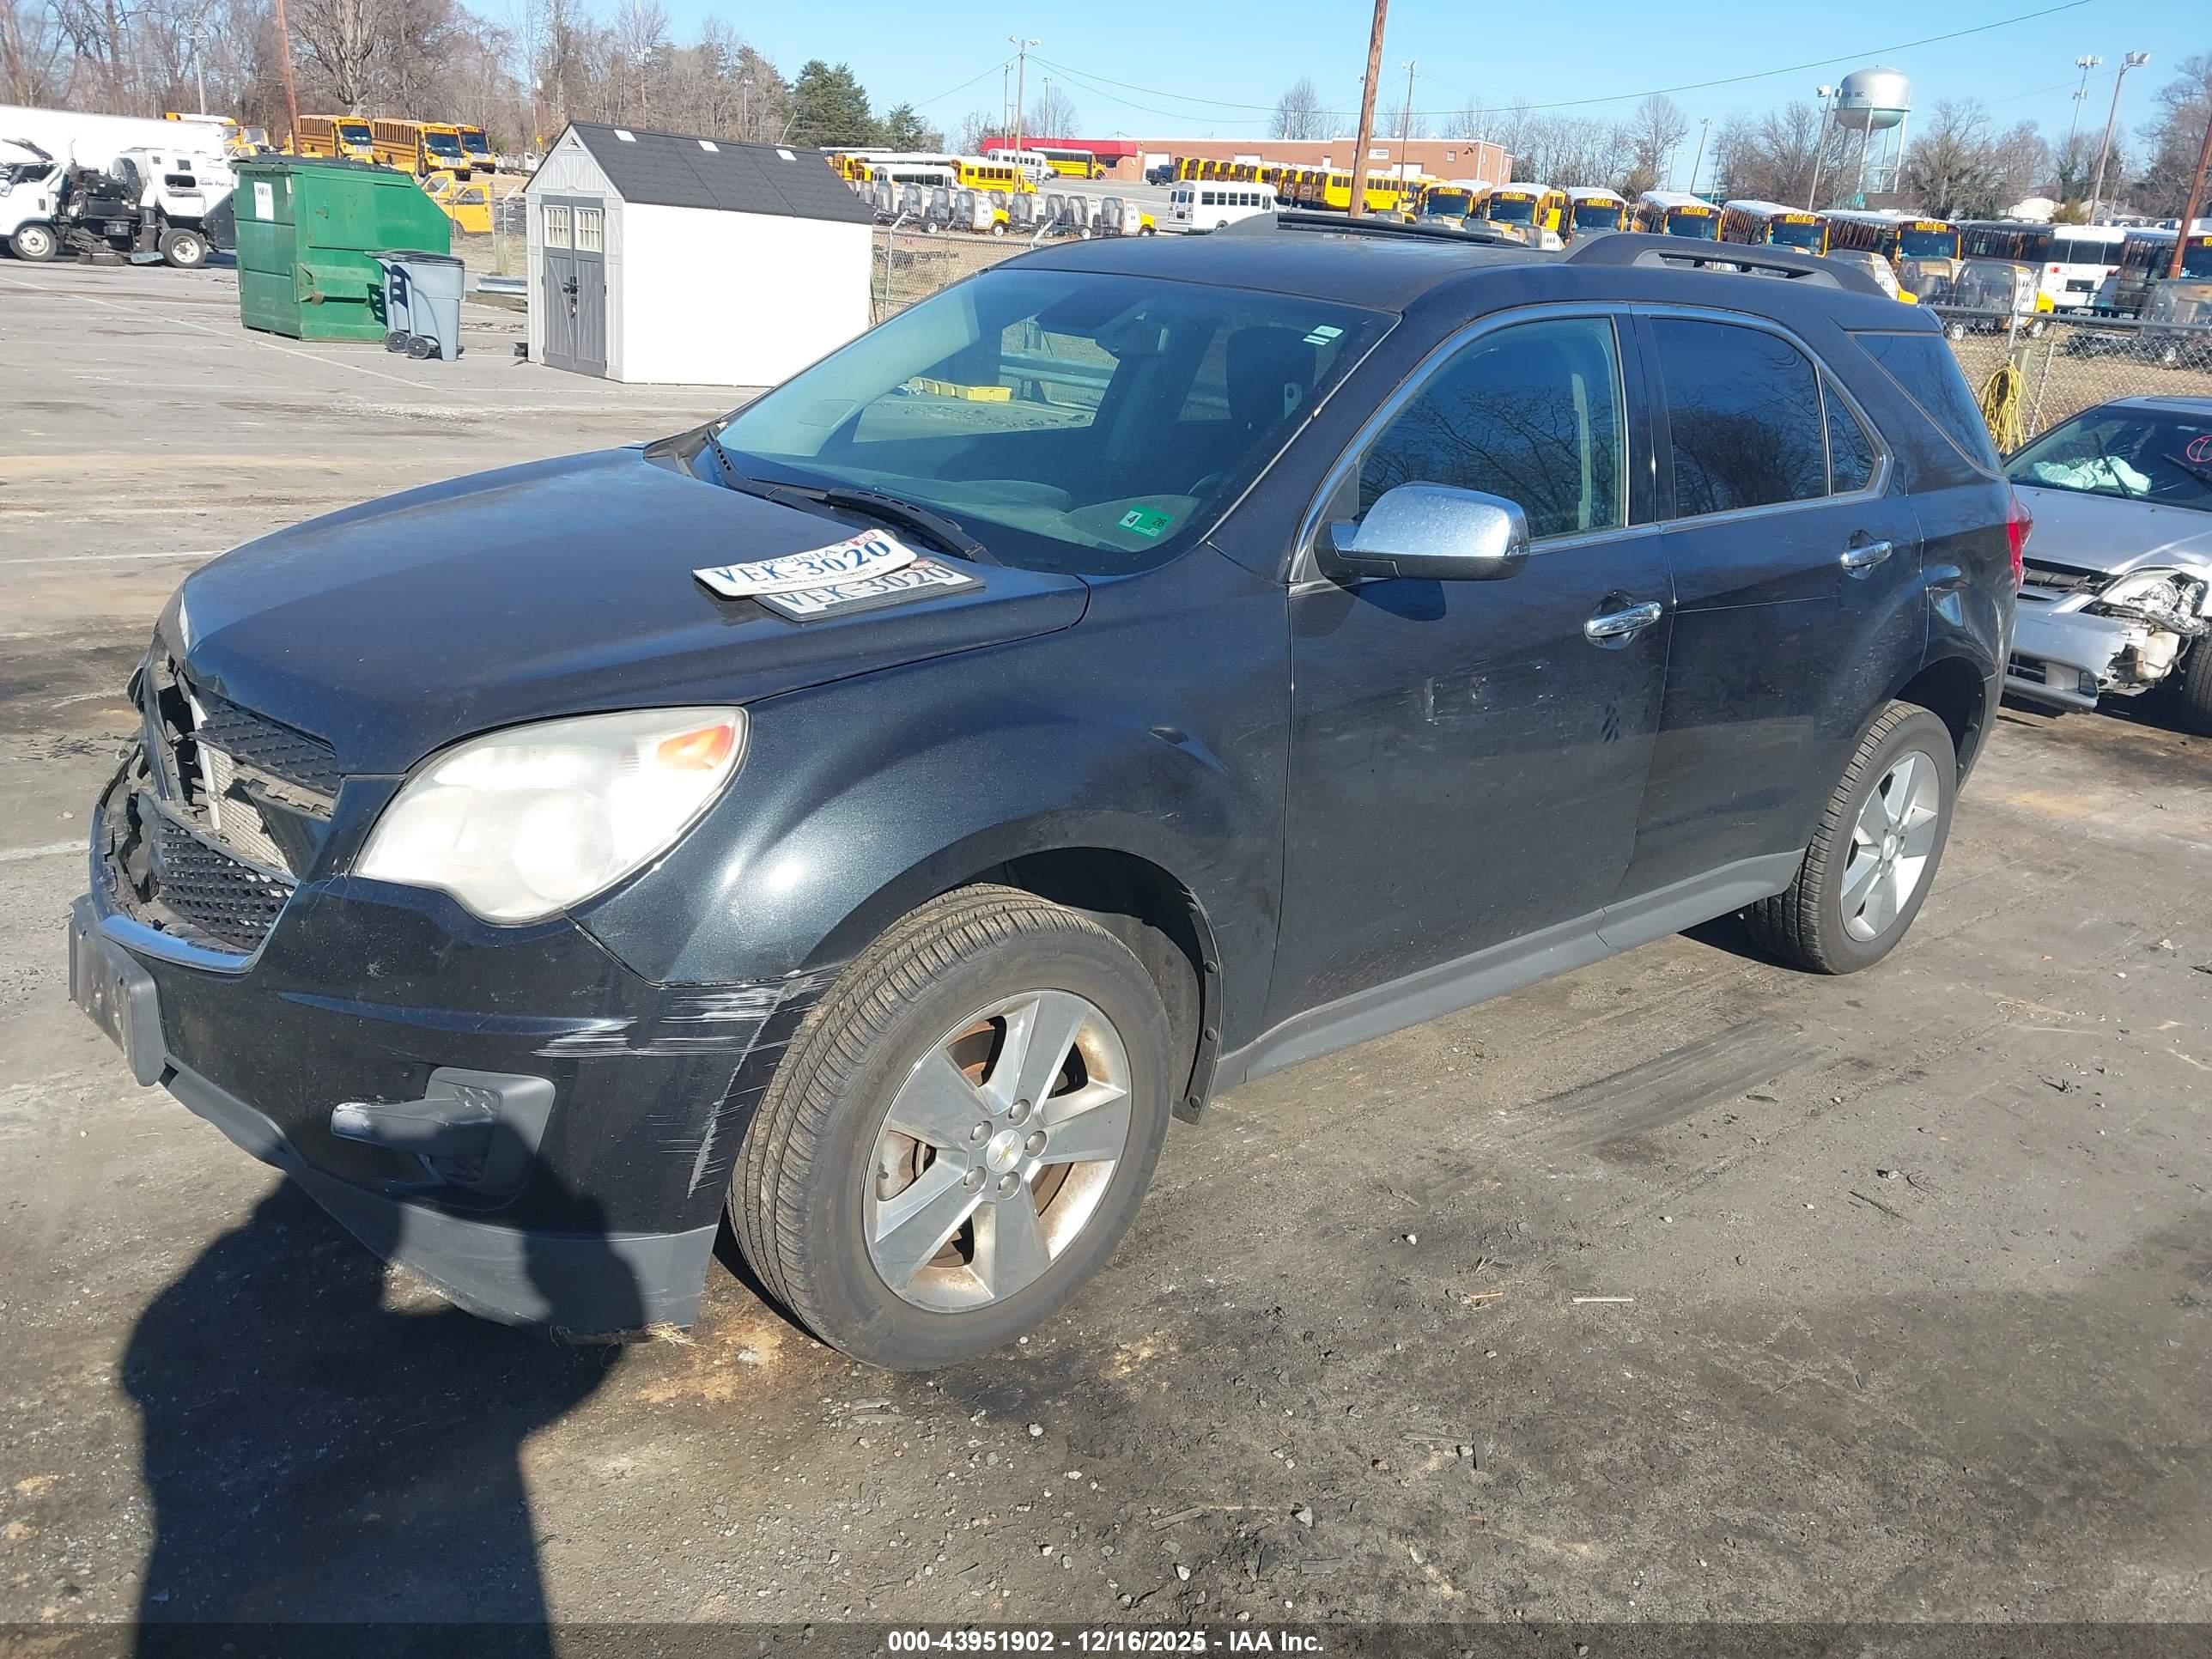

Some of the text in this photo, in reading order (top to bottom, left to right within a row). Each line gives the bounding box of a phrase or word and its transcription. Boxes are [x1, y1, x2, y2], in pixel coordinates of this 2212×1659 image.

[1127, 515, 1166, 527] 4 26
[712, 541, 891, 583] VEK-3020
[776, 568, 953, 606] VEK-3020
